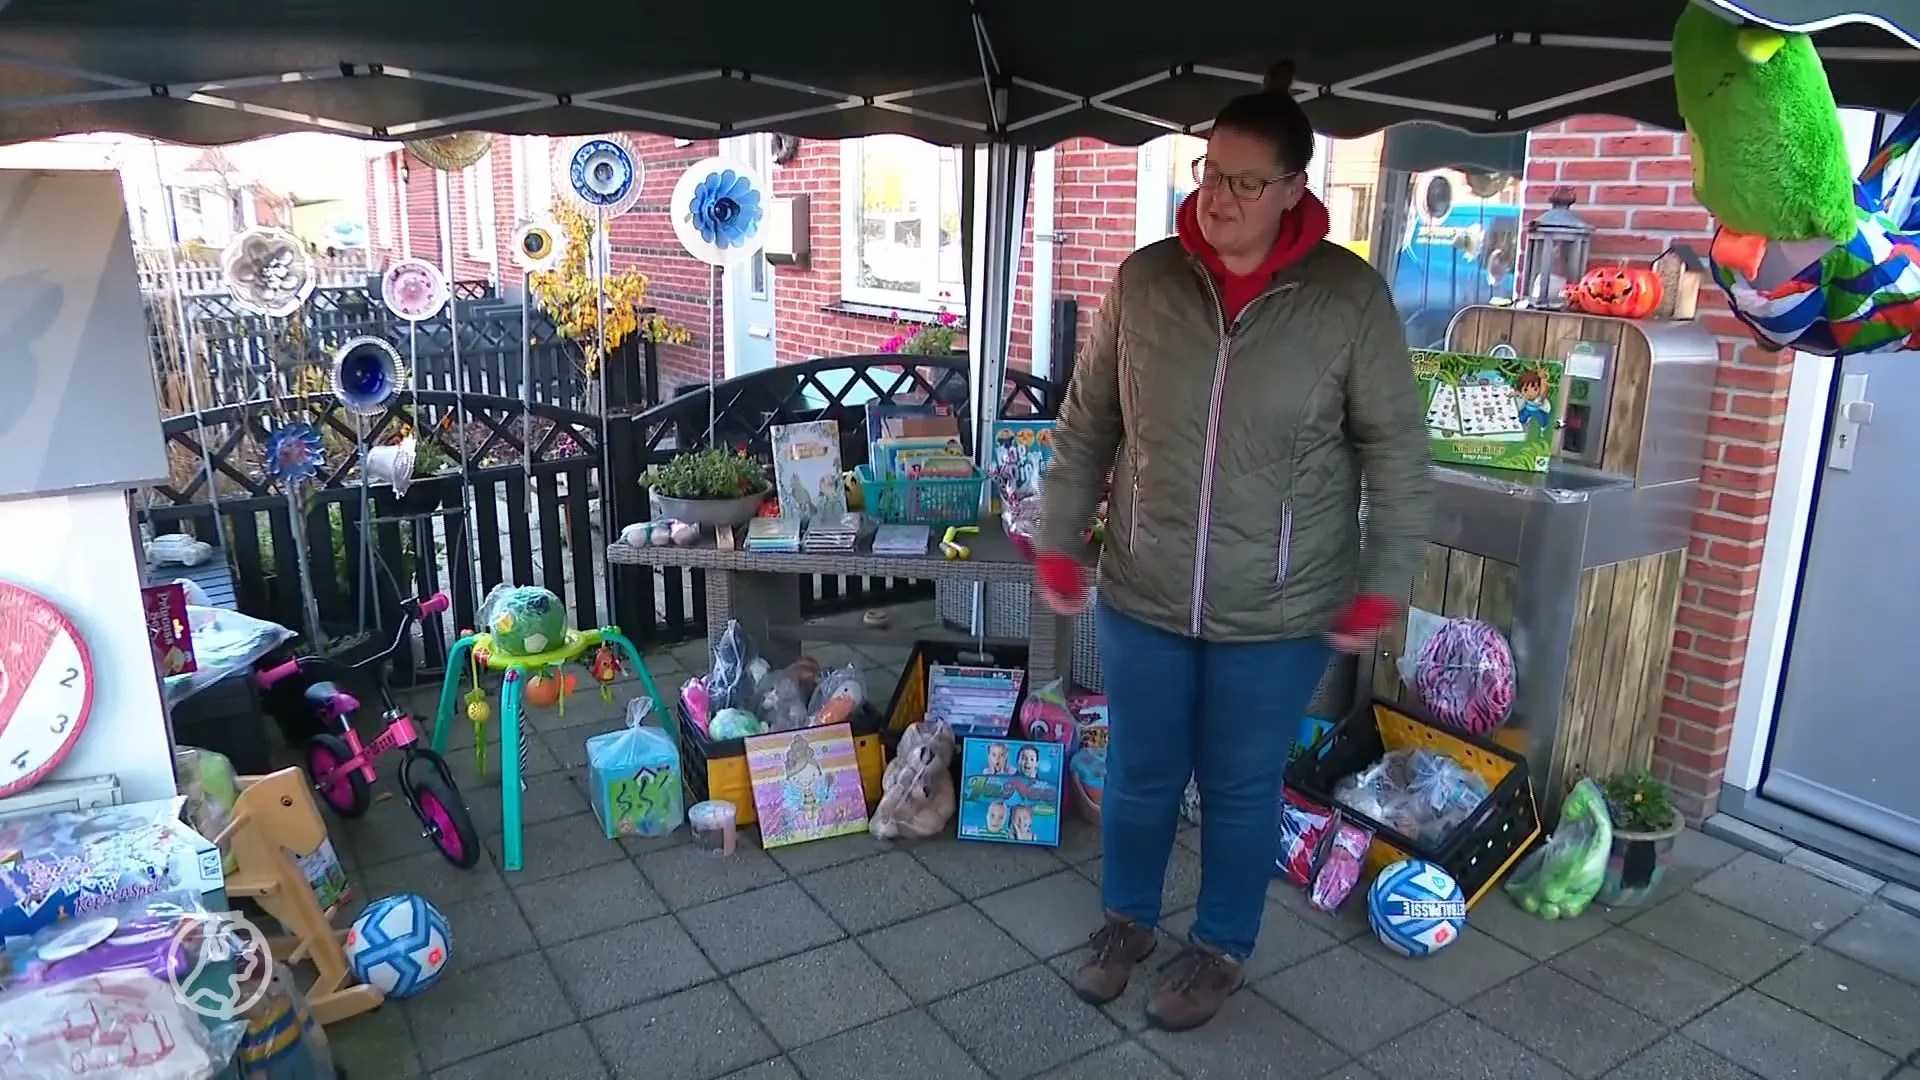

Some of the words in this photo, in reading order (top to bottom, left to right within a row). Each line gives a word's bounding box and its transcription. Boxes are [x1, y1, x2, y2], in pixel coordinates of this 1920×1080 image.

[59, 667, 79, 689] 2
[50, 714, 69, 734] 3
[10, 749, 30, 769] 4
